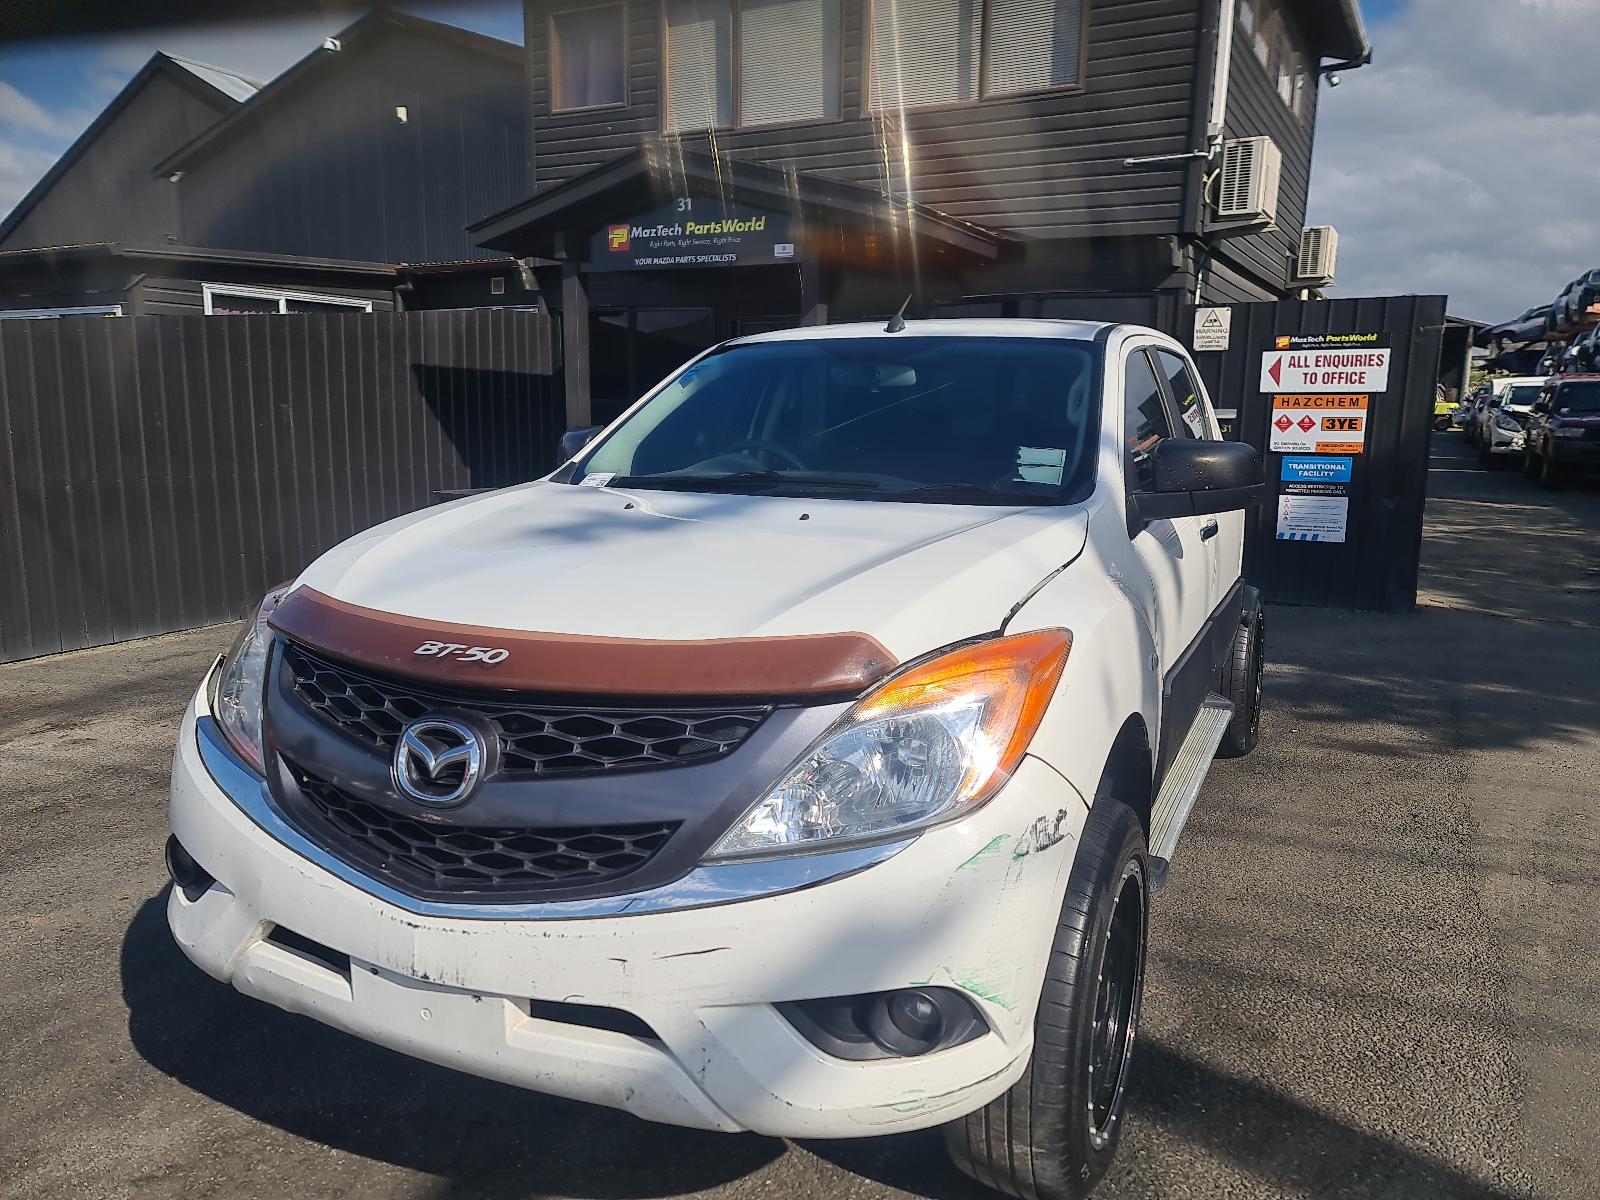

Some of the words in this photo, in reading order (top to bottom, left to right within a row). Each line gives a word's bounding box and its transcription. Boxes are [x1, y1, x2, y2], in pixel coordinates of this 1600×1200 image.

[677, 197, 692, 211] 31
[631, 223, 682, 239] MazTech
[686, 216, 766, 235] PartsWorld
[634, 257, 652, 266] YOUR
[653, 256, 674, 265] MAZDA
[675, 255, 697, 264] PARTS
[697, 253, 737, 263] SPECIALISTS
[1290, 335, 1324, 343] MazTech
[1326, 333, 1378, 342] PartsWorld
[1288, 355, 1310, 369] ALL
[1315, 353, 1385, 368] ENQUIRIES
[1302, 373, 1317, 385] TO
[1322, 371, 1366, 385] OFFICE
[1281, 397, 1360, 407] HAZCHEM
[1221, 424, 1232, 433] 31
[1325, 418, 1358, 430] 3YE
[413, 640, 510, 664] BT-50
